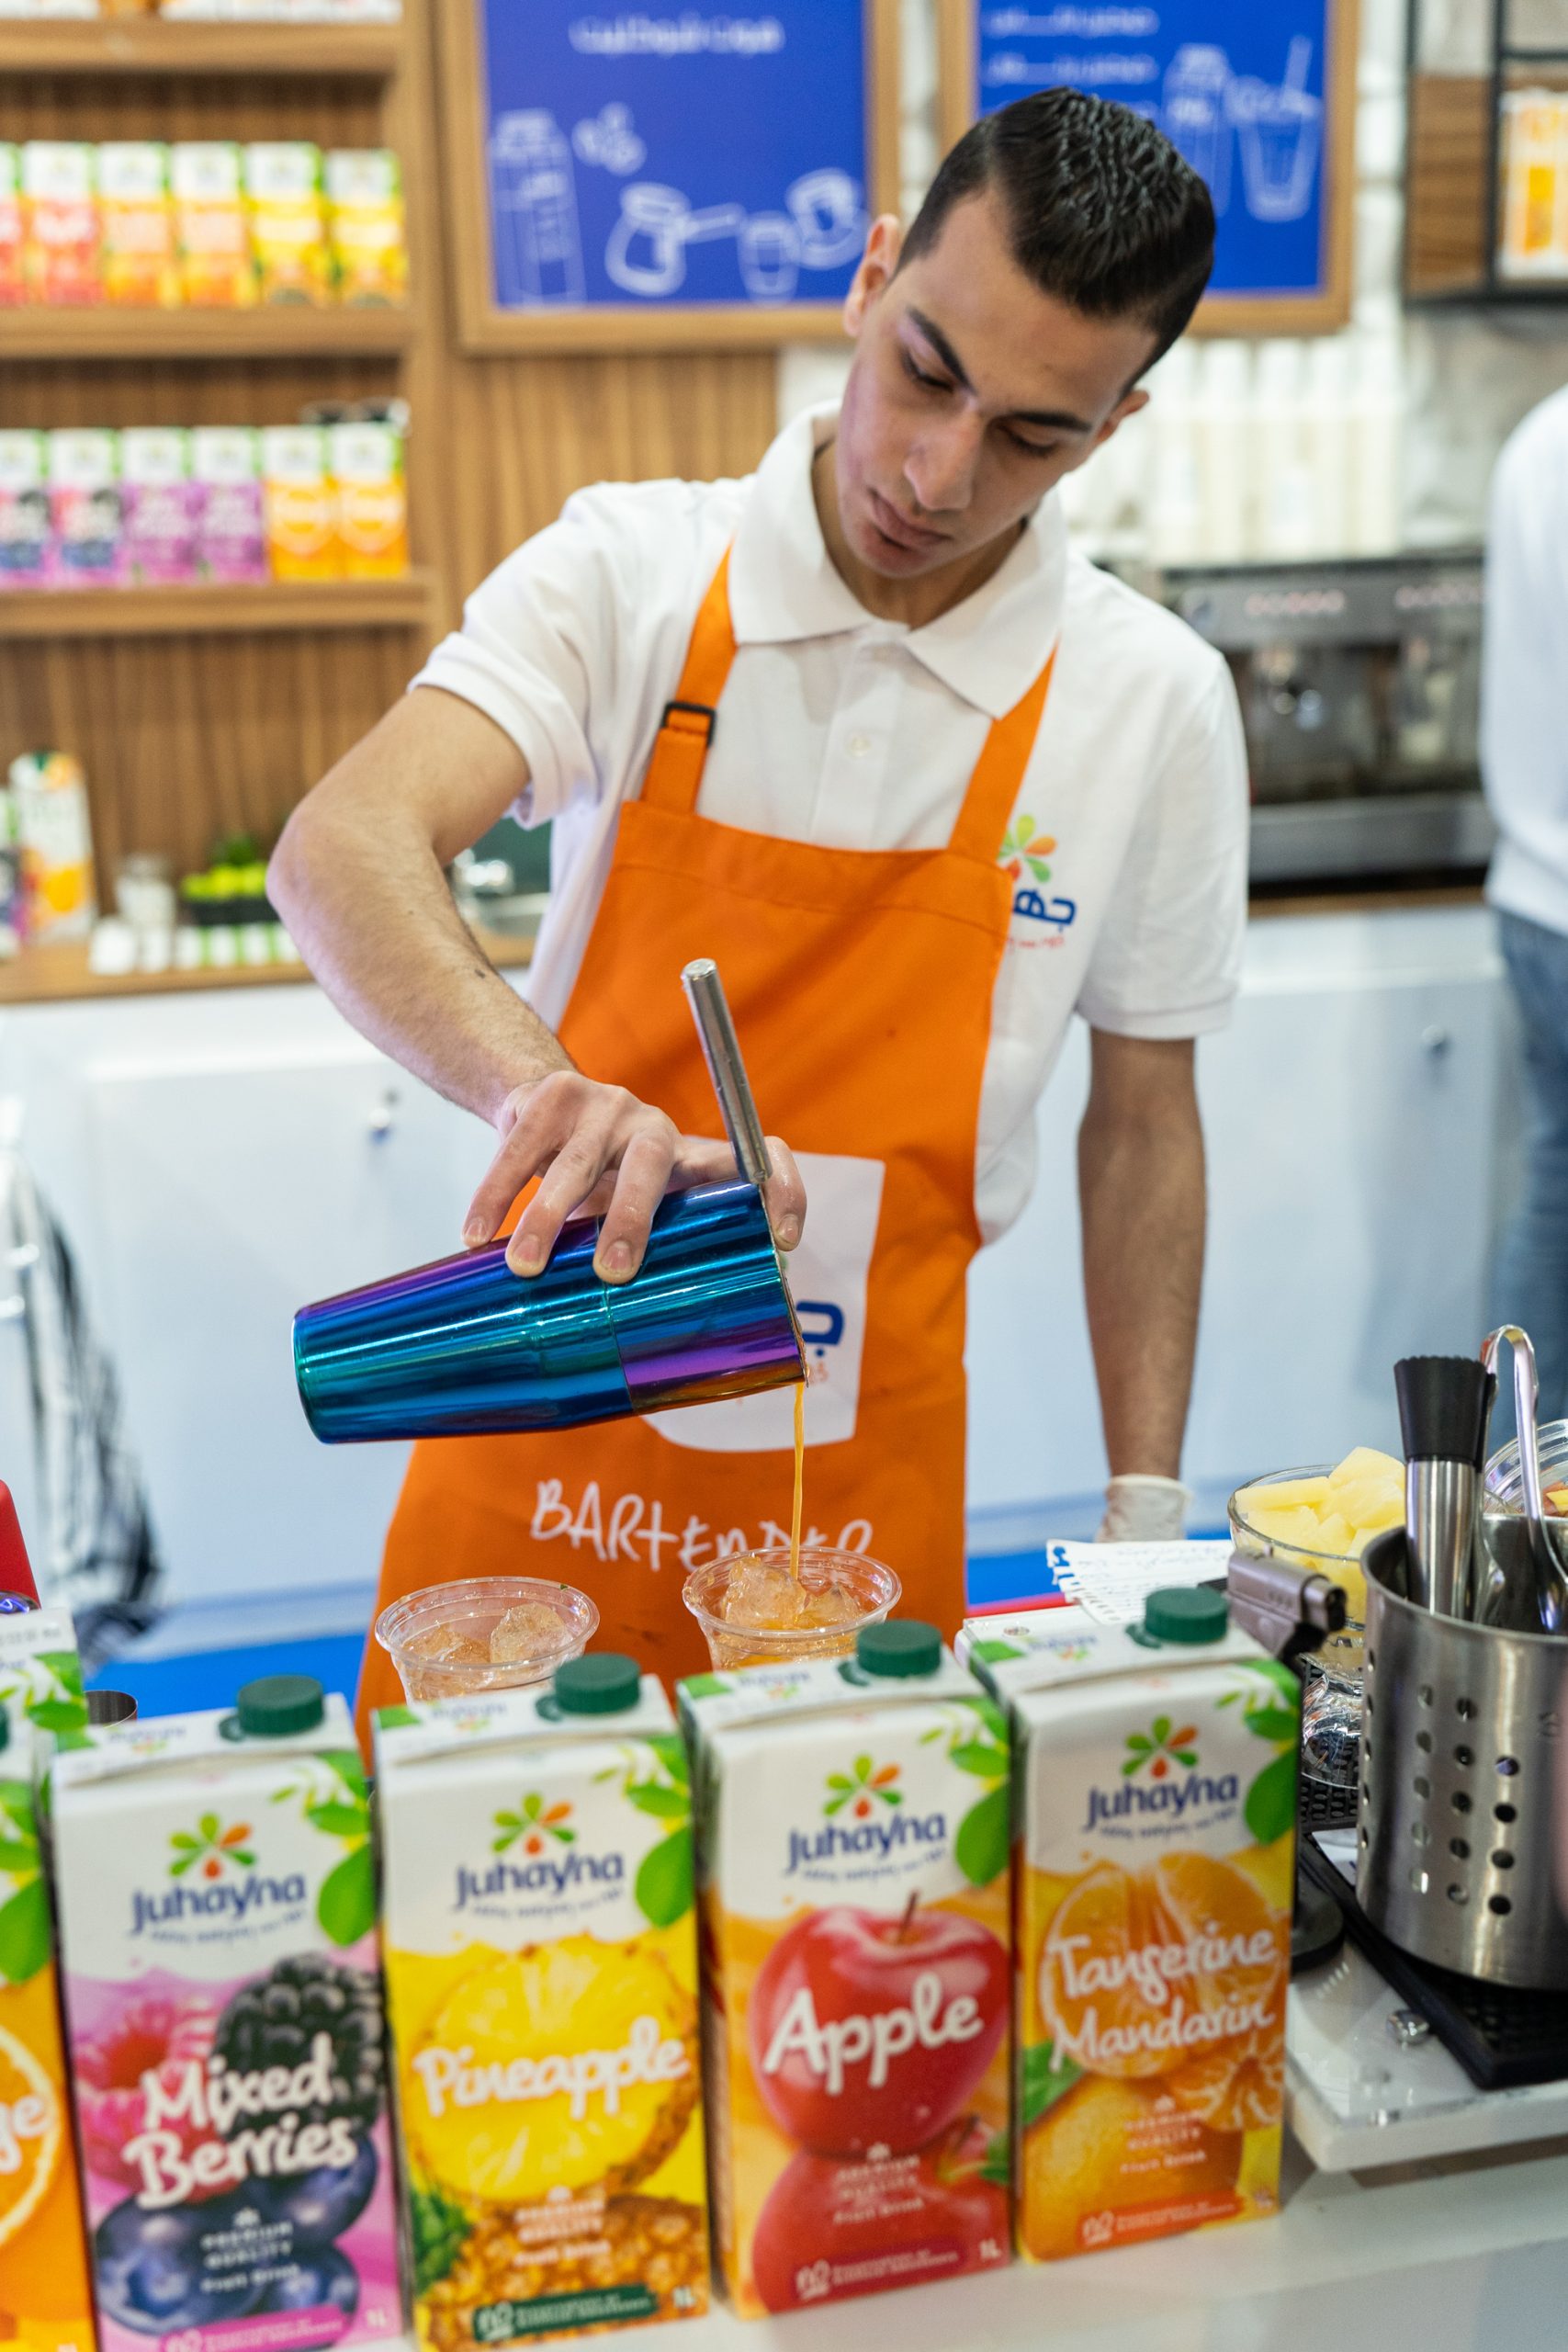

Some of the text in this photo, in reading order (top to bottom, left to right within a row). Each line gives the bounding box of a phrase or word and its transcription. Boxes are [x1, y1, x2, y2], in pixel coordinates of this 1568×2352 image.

[1083, 1773, 1238, 1833] Juhayna
[454, 1853, 624, 1911] Juhayna
[784, 1815, 945, 1875] Juhayna
[130, 1873, 307, 1937] Juhayna
[1045, 1919, 1278, 2006] Tangerine
[412, 2015, 690, 2120] Pineapple
[762, 1972, 985, 2097] Apple
[1049, 1995, 1276, 2073] Mandarin
[141, 2030, 333, 2133] Mixed
[121, 2111, 357, 2210] Berries
